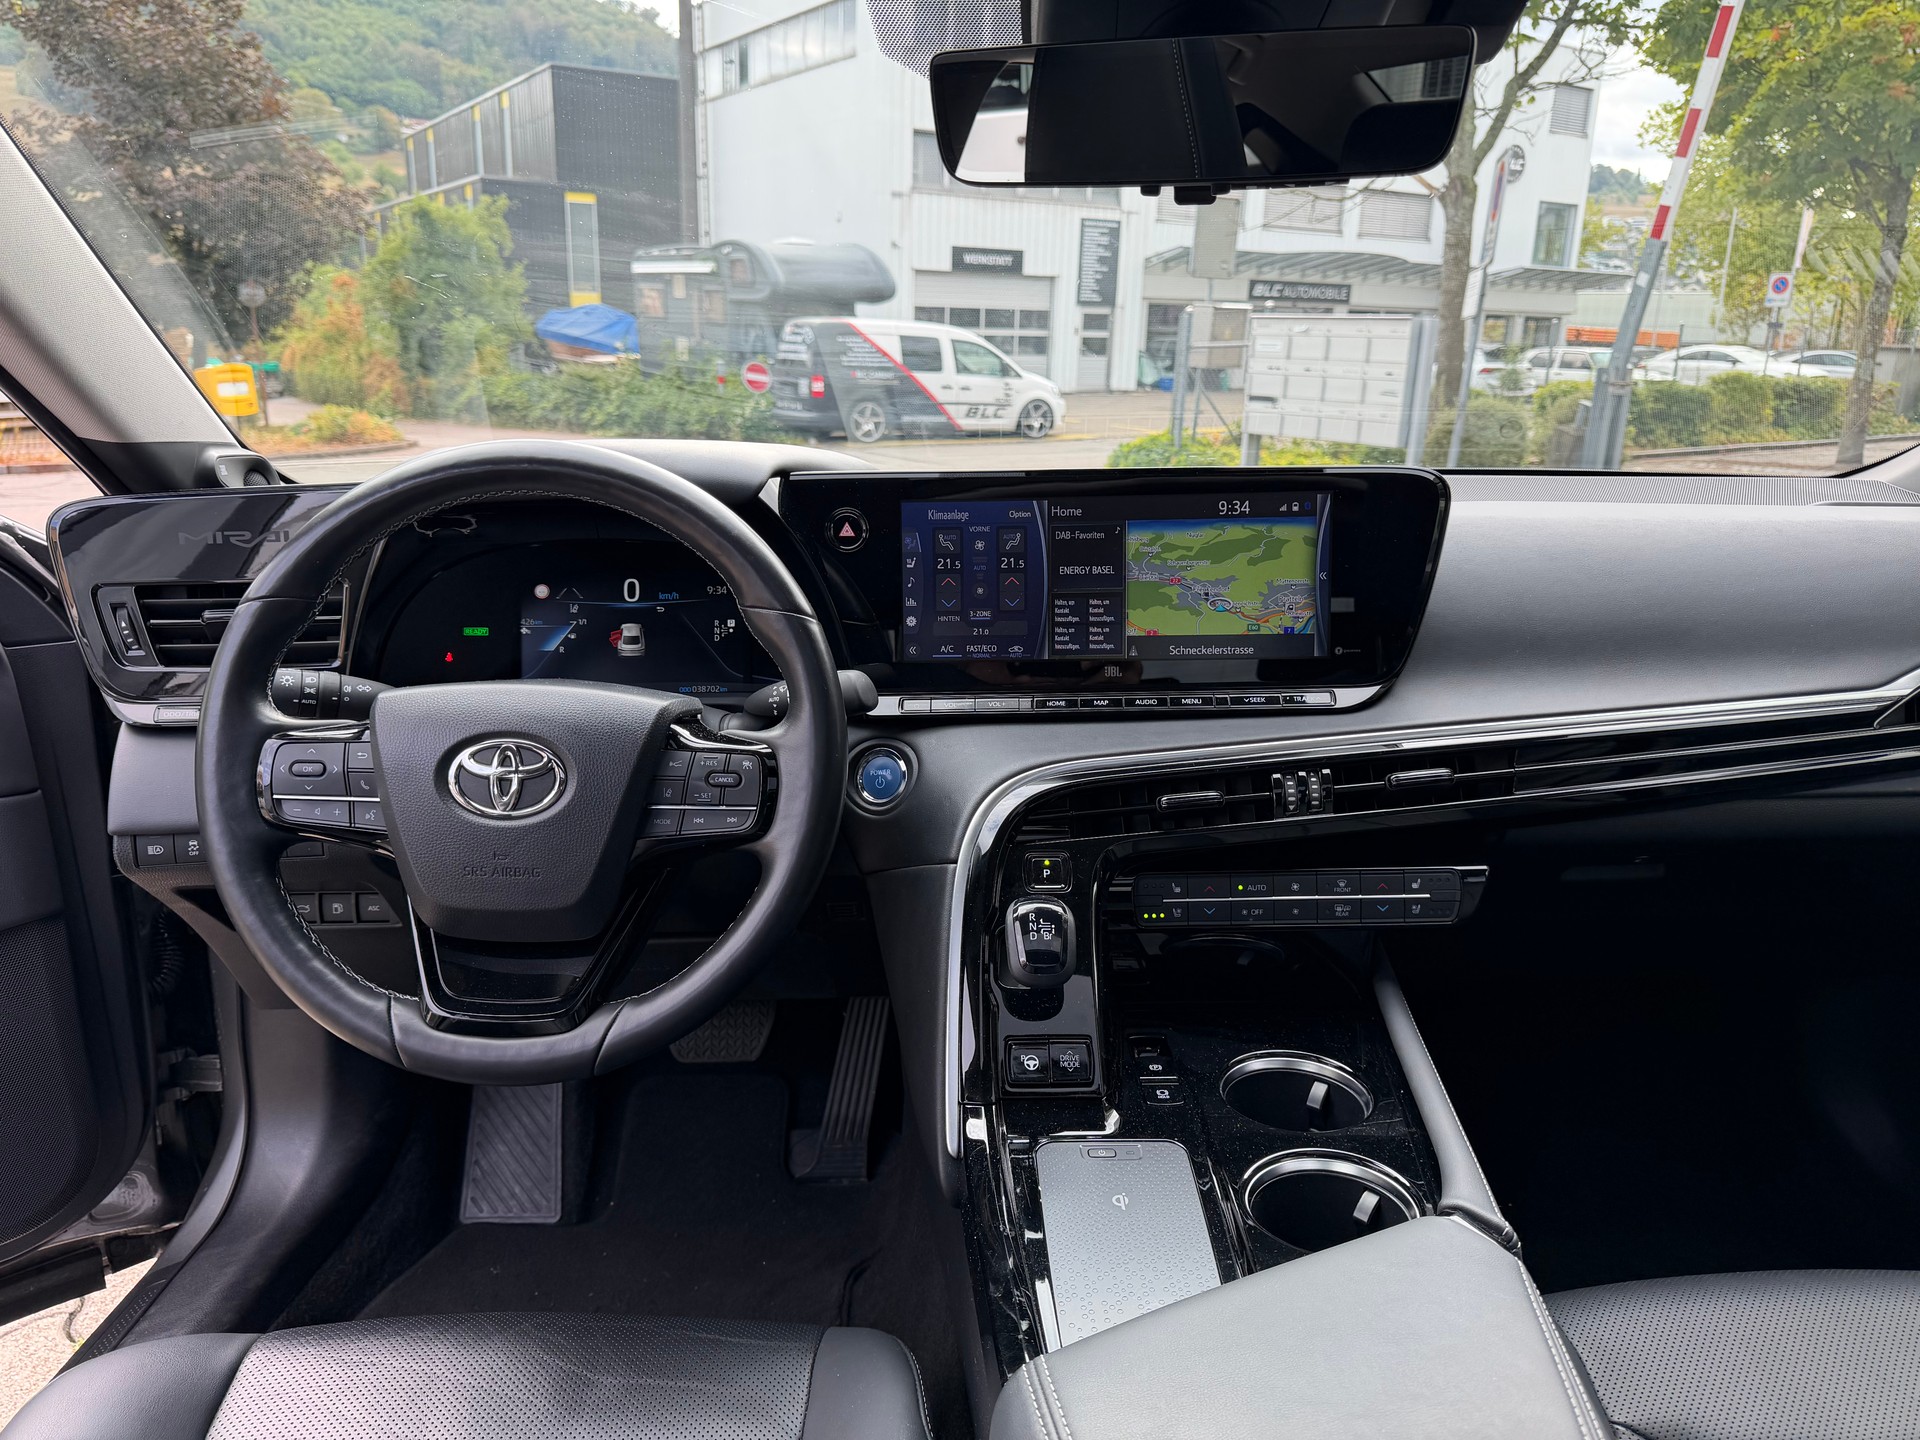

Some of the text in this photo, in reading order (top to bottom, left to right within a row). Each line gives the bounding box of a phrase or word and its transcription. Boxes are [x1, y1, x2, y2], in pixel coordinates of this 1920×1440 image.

[1283, 285, 1348, 299] AUTOMOBILE
[966, 407, 1008, 418] BLC
[1051, 506, 1082, 517] Home
[1218, 500, 1251, 515] 9:34
[928, 510, 969, 521] Klimaanlage
[1009, 510, 1031, 519] Option
[178, 531, 290, 548] MIRAI
[1055, 531, 1105, 540] DAB-Favoriten
[937, 558, 961, 569] 21.5
[1001, 557, 1025, 569] 21.5
[1059, 566, 1115, 575] ENERGY BASEL
[623, 579, 679, 602] 0 km/h
[707, 586, 727, 595] 9:34
[940, 645, 954, 653] A/C
[966, 645, 997, 653] FAST/ECO
[1169, 645, 1254, 656] Schneckelerstrasse
[1104, 666, 1122, 677] JBL
[463, 866, 541, 878] SRS AIRBAG
[1043, 869, 1051, 878] P
[1029, 913, 1036, 921] R
[1029, 922, 1037, 931] N
[1030, 931, 1037, 940] D
